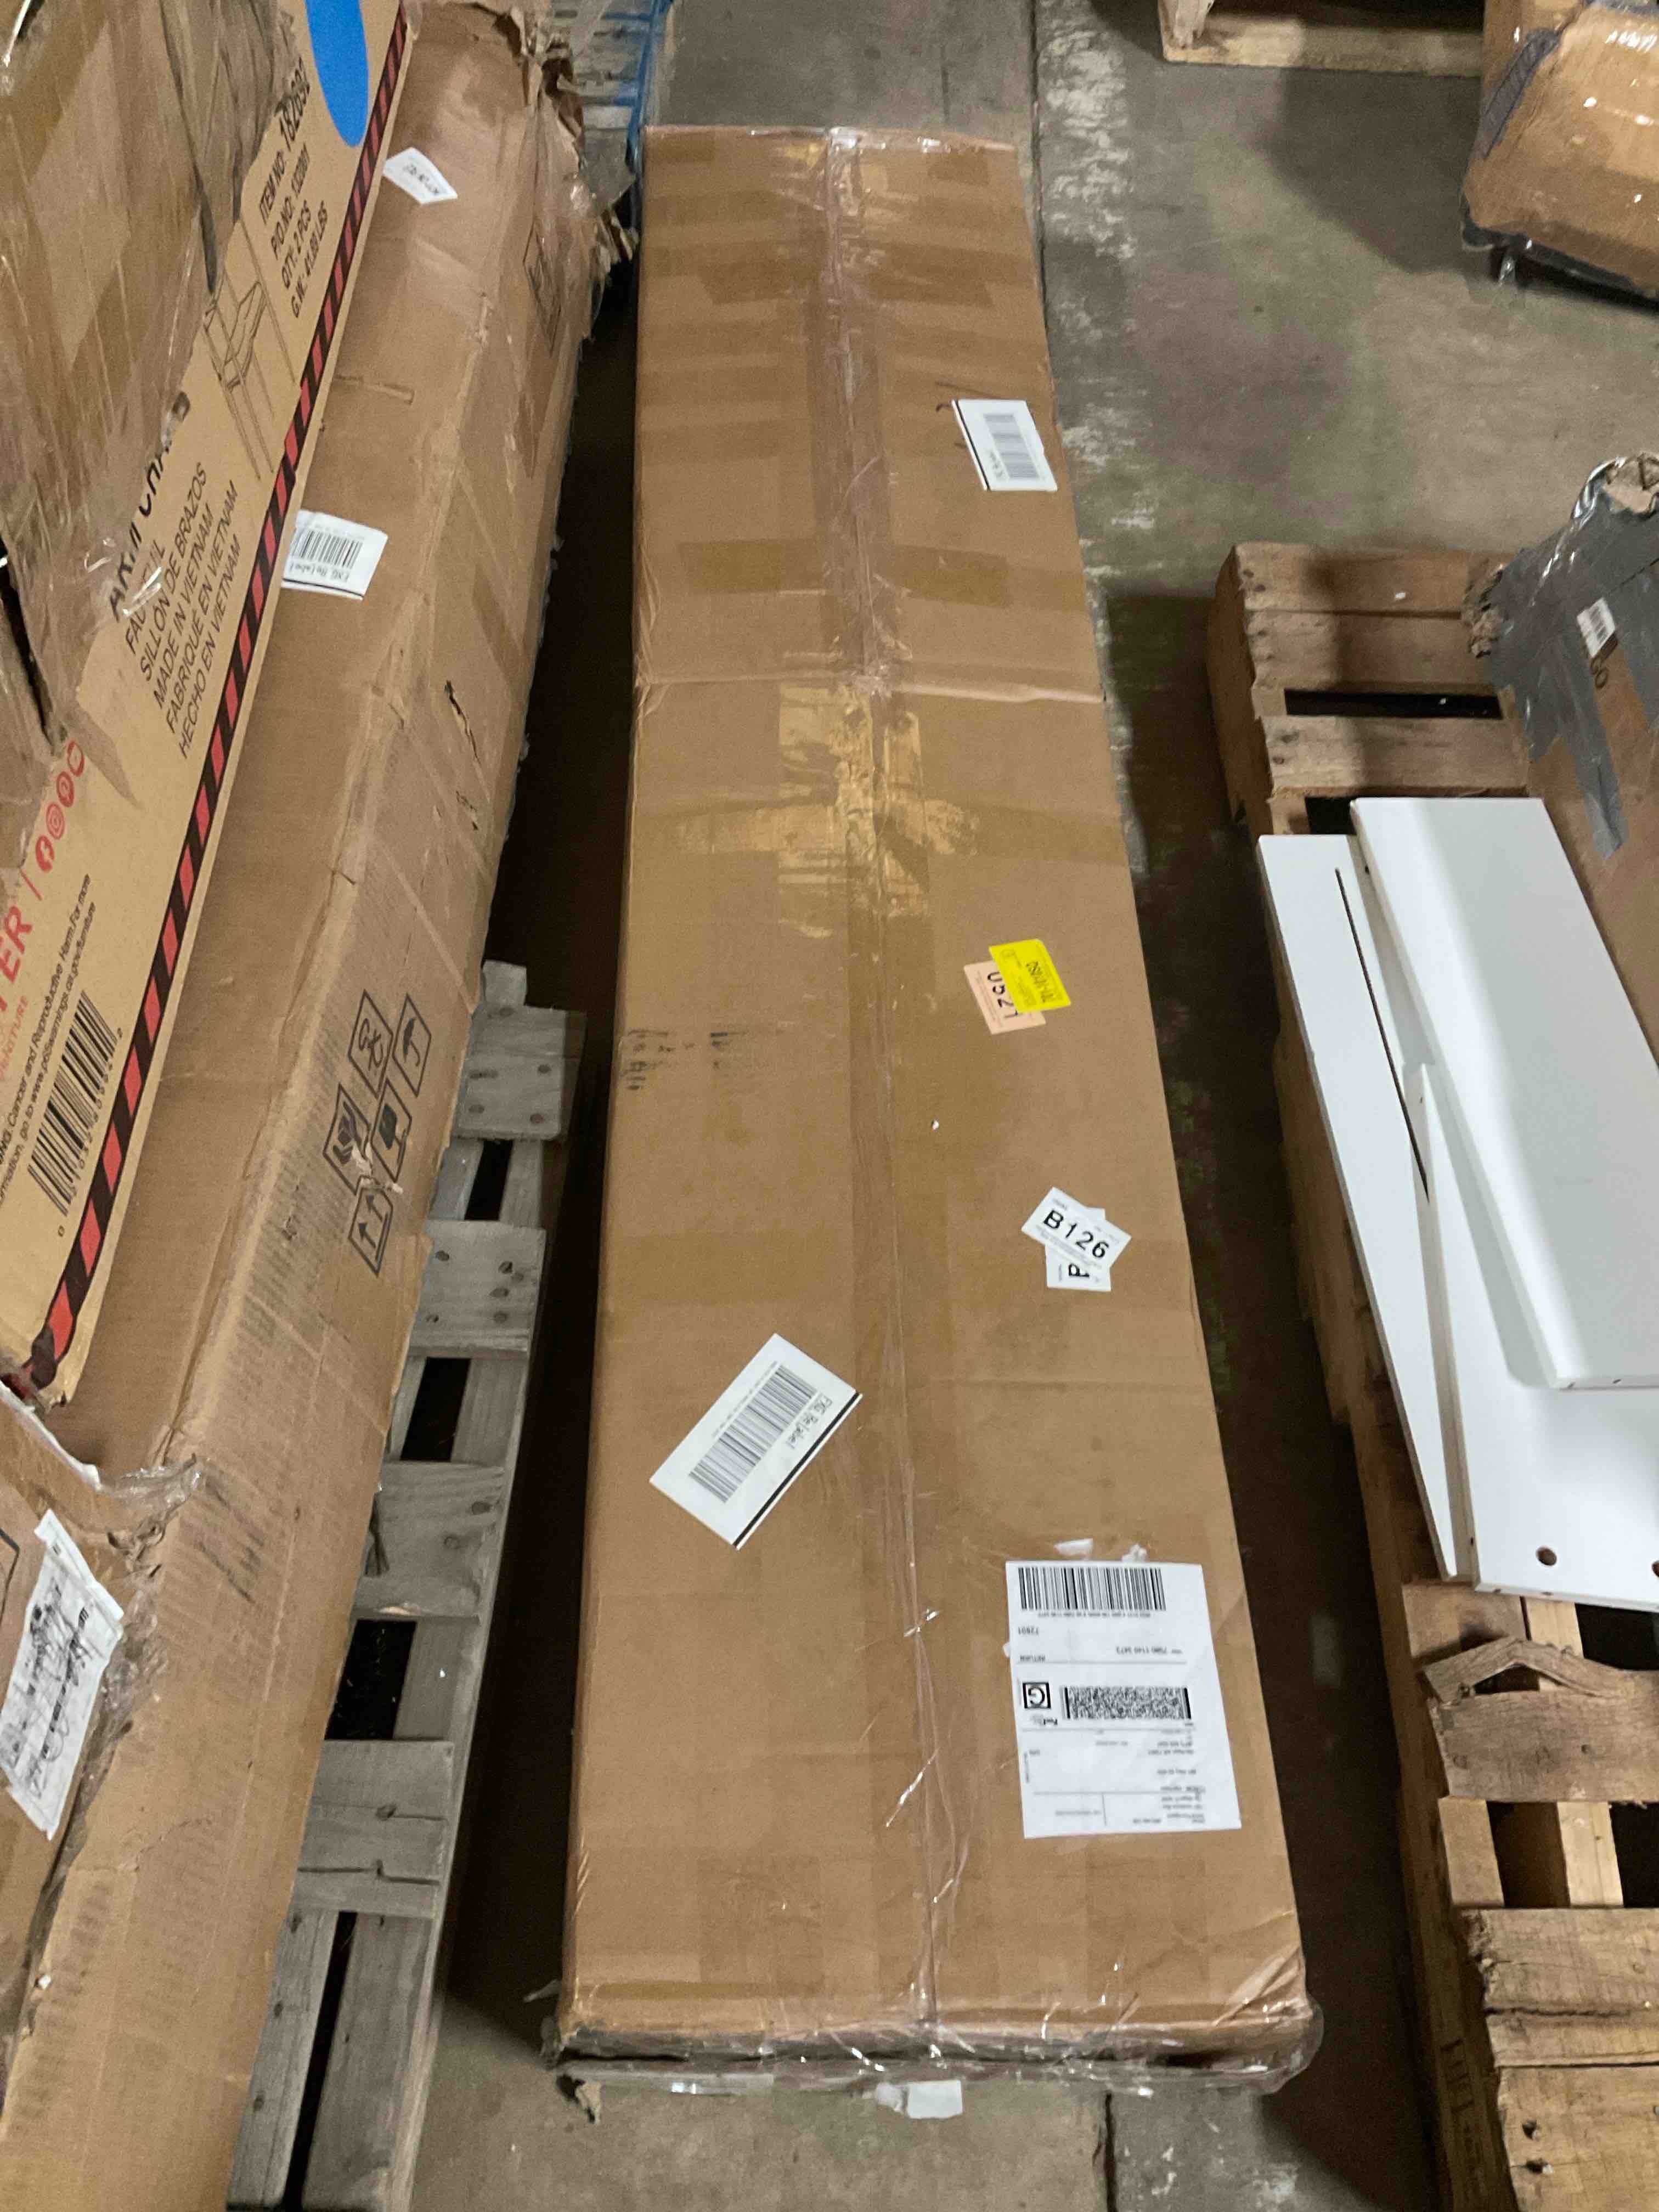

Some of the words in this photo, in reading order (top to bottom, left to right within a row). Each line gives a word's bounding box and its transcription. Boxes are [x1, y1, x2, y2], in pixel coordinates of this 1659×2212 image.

[259, 173, 276, 224] ITEM
[298, 199, 311, 242] PCS
[165, 551, 182, 595] DE
[174, 461, 207, 559] BRAZOS
[198, 574, 213, 616] EN
[207, 479, 238, 577] VIETNAM
[153, 630, 179, 709] MADE
[173, 601, 187, 636] IN
[180, 502, 214, 605] VIETNAM
[178, 669, 207, 759] HECHO
[202, 631, 216, 672] EN
[211, 533, 241, 633] VIETNAM
[8, 1075, 27, 1127] Cancer
[25, 1046, 37, 1077] and
[32, 963, 63, 1048] Reproductive
[78, 873, 91, 906] more
[20, 1120, 30, 1142] go
[25, 1104, 33, 1120] to
[1043, 1210, 1109, 1258] B126
[1028, 1686, 1045, 1706] G
